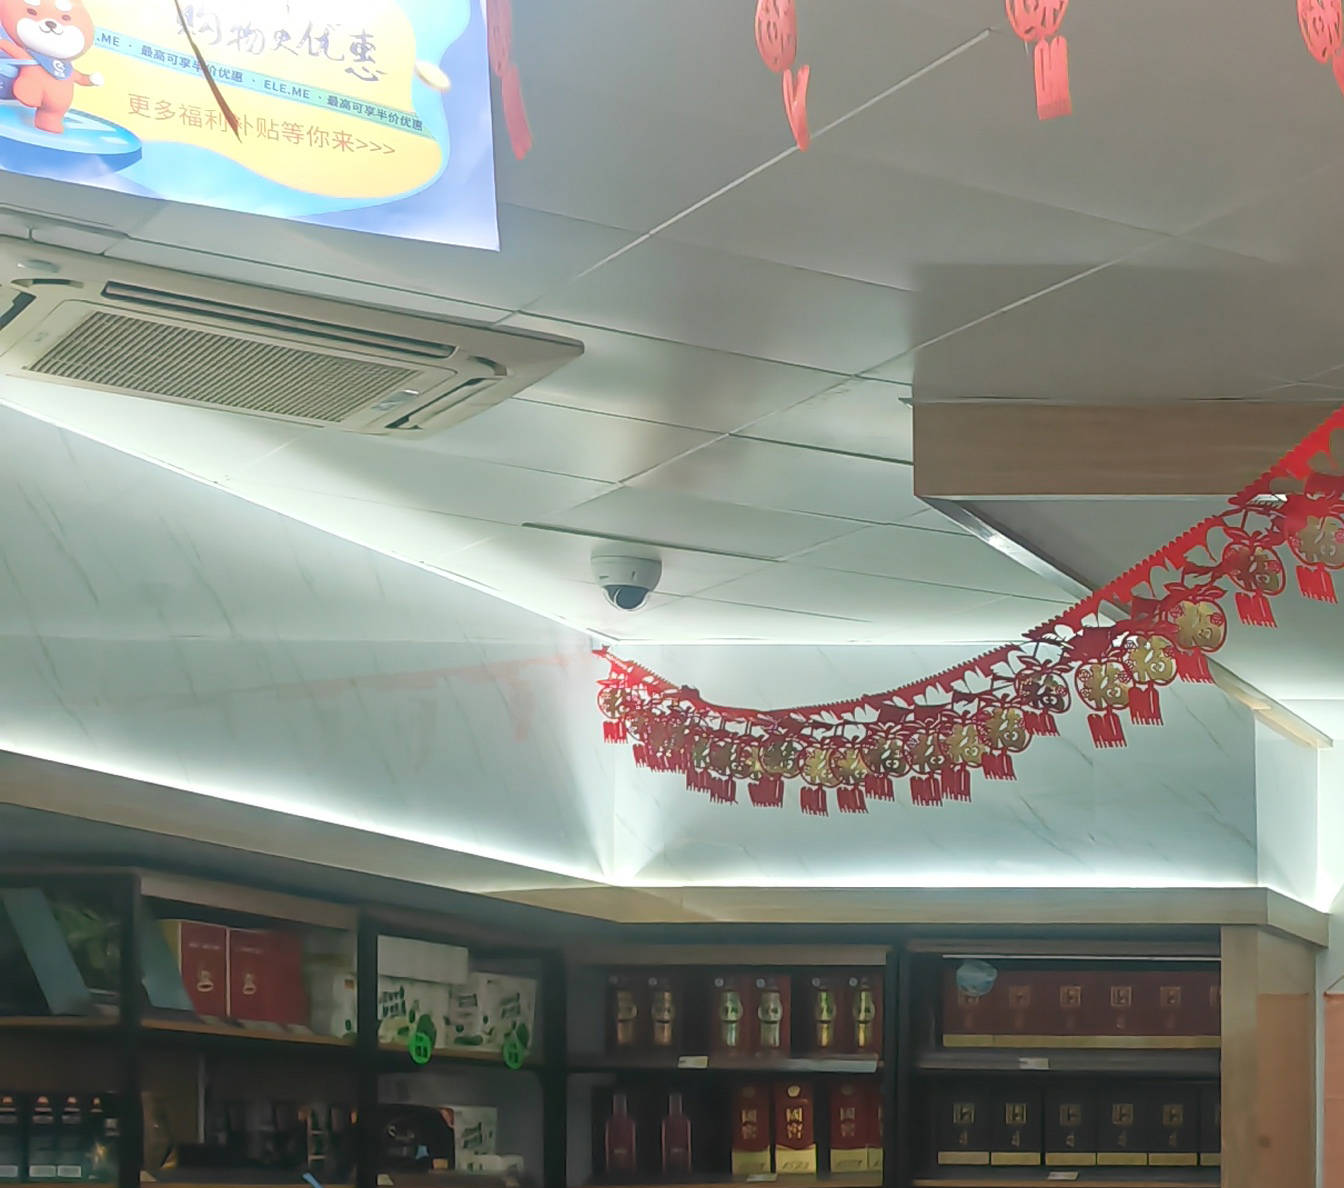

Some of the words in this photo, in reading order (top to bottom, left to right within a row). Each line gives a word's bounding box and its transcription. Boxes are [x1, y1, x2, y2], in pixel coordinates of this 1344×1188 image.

[264, 80, 311, 100] ELE.ME
[326, 95, 423, 132] 最高可享半价优惠
